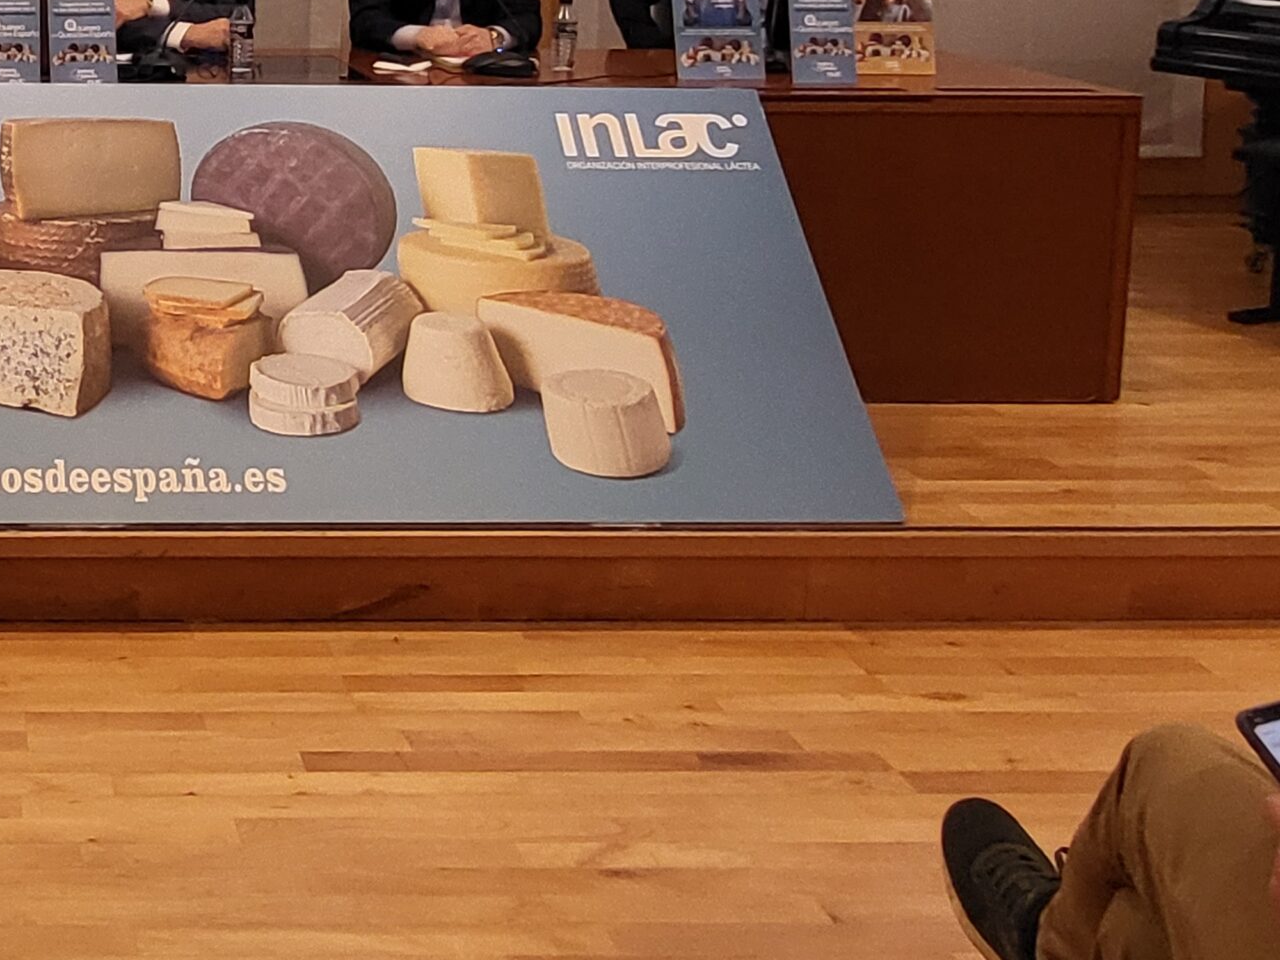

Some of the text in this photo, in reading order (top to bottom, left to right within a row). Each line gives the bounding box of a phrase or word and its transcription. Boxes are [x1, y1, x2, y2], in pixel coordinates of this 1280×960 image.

[566, 160, 762, 171] ORGANIZACIÓN INTERPROFESIONAL LÁCTEA
